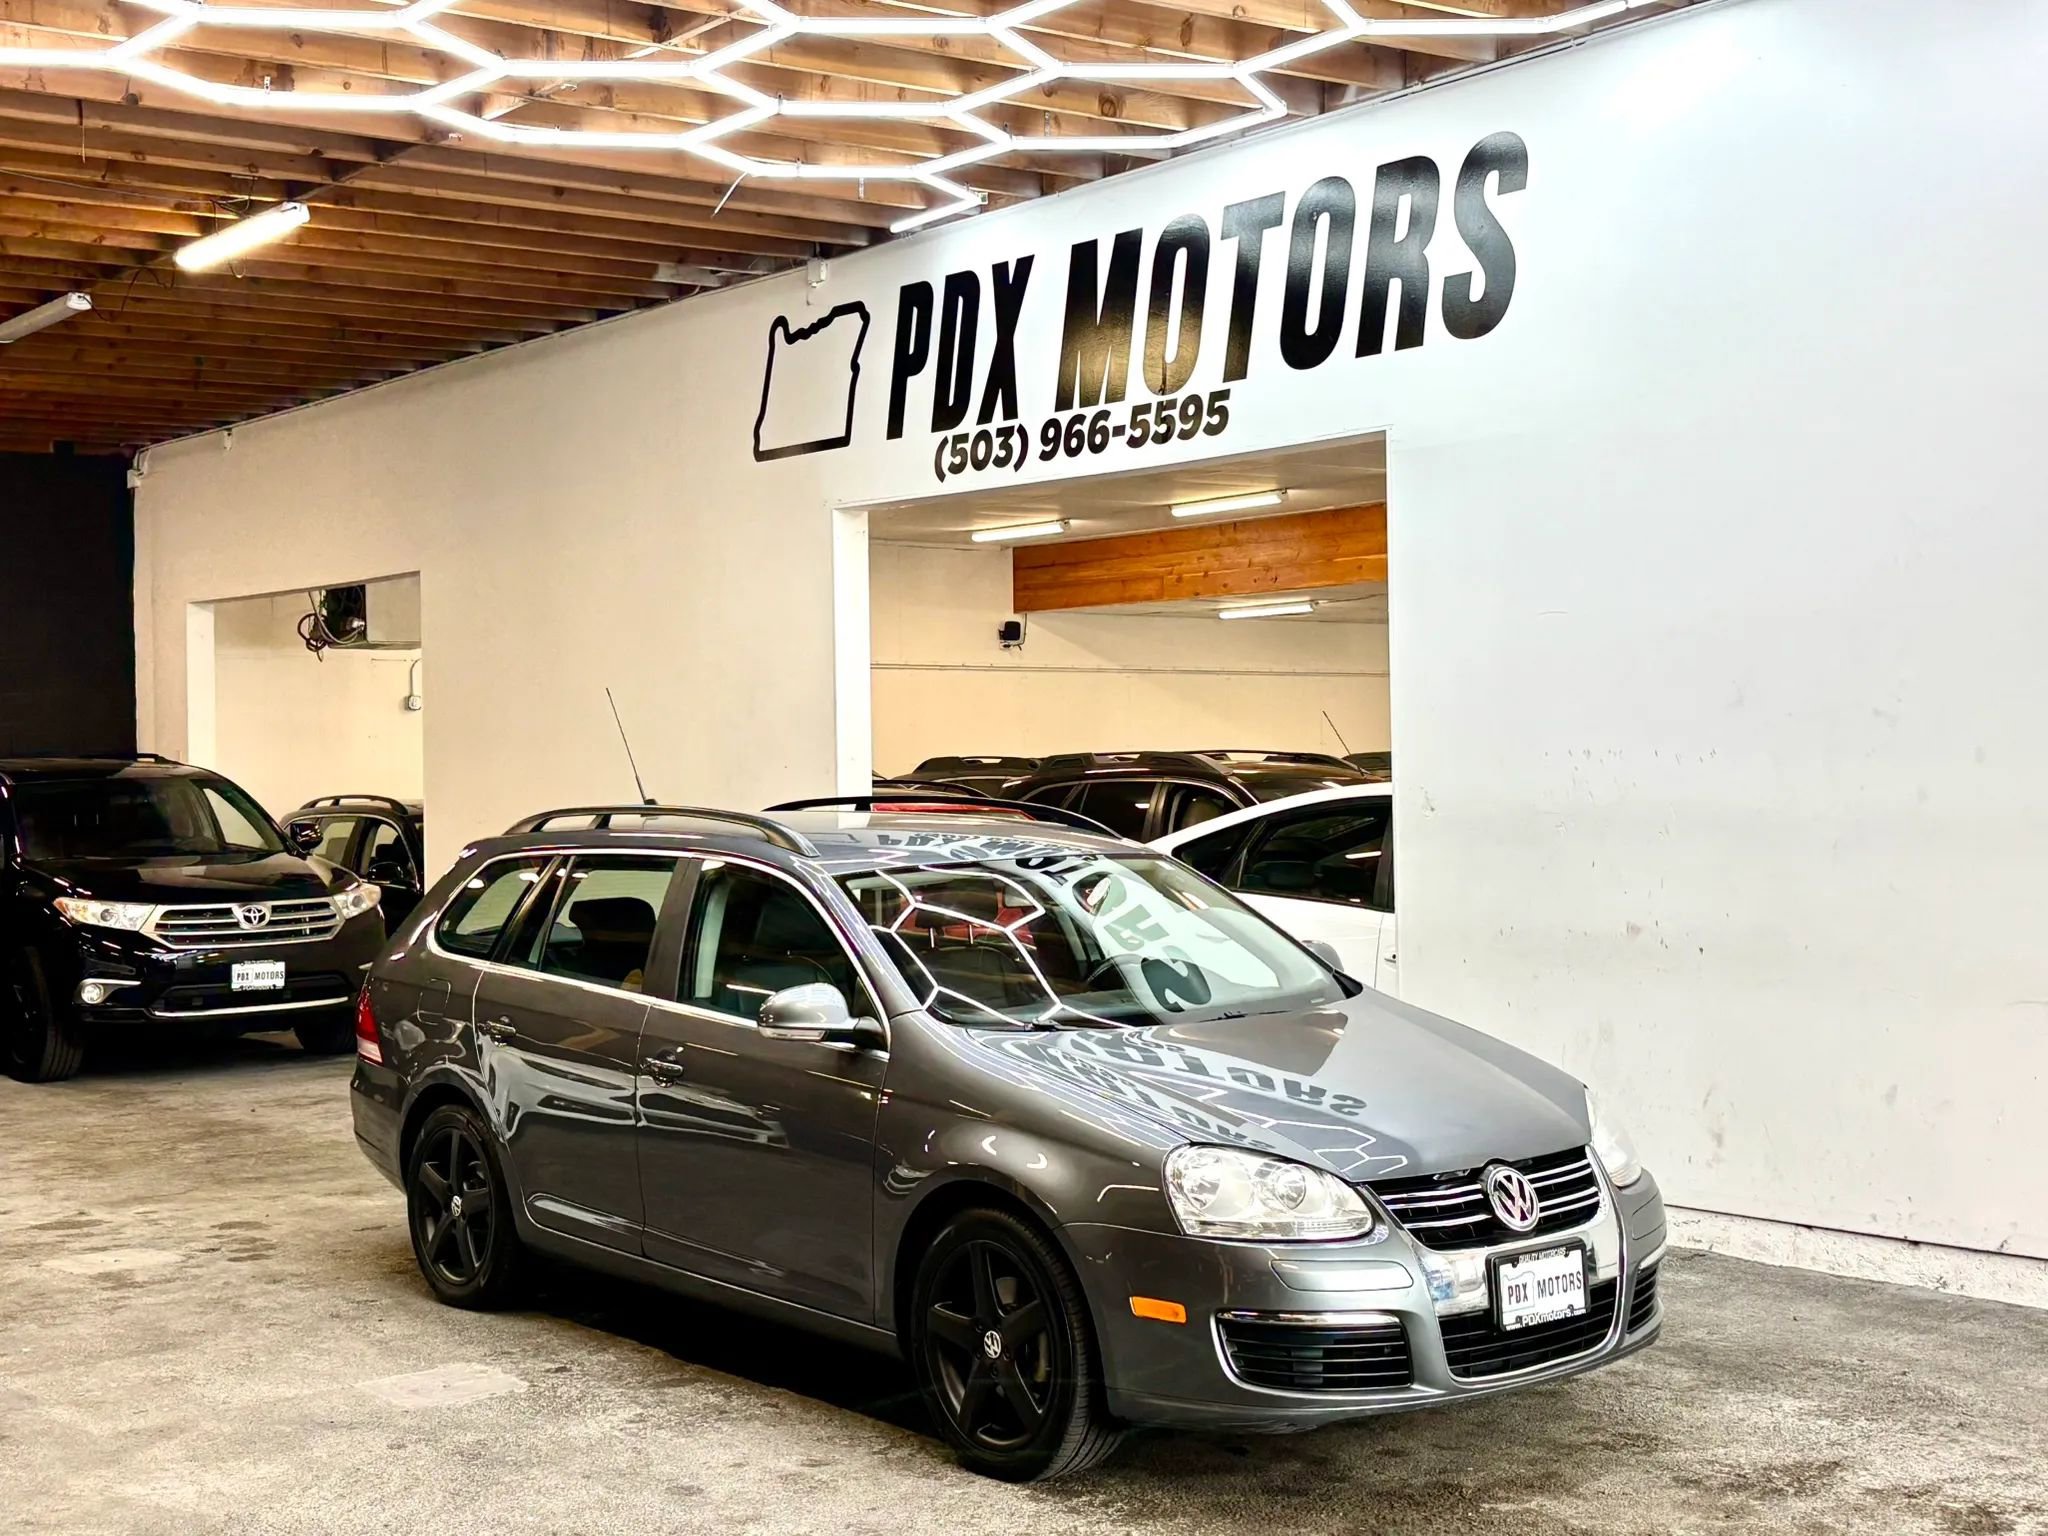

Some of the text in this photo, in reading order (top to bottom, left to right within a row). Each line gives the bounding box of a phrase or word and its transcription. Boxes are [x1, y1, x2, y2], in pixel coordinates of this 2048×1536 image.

[886, 131, 1529, 440] PDX MOTORS
[934, 389, 1231, 483] (503) 966-5595
[1507, 1271, 1582, 1305] PDX MOTORS
